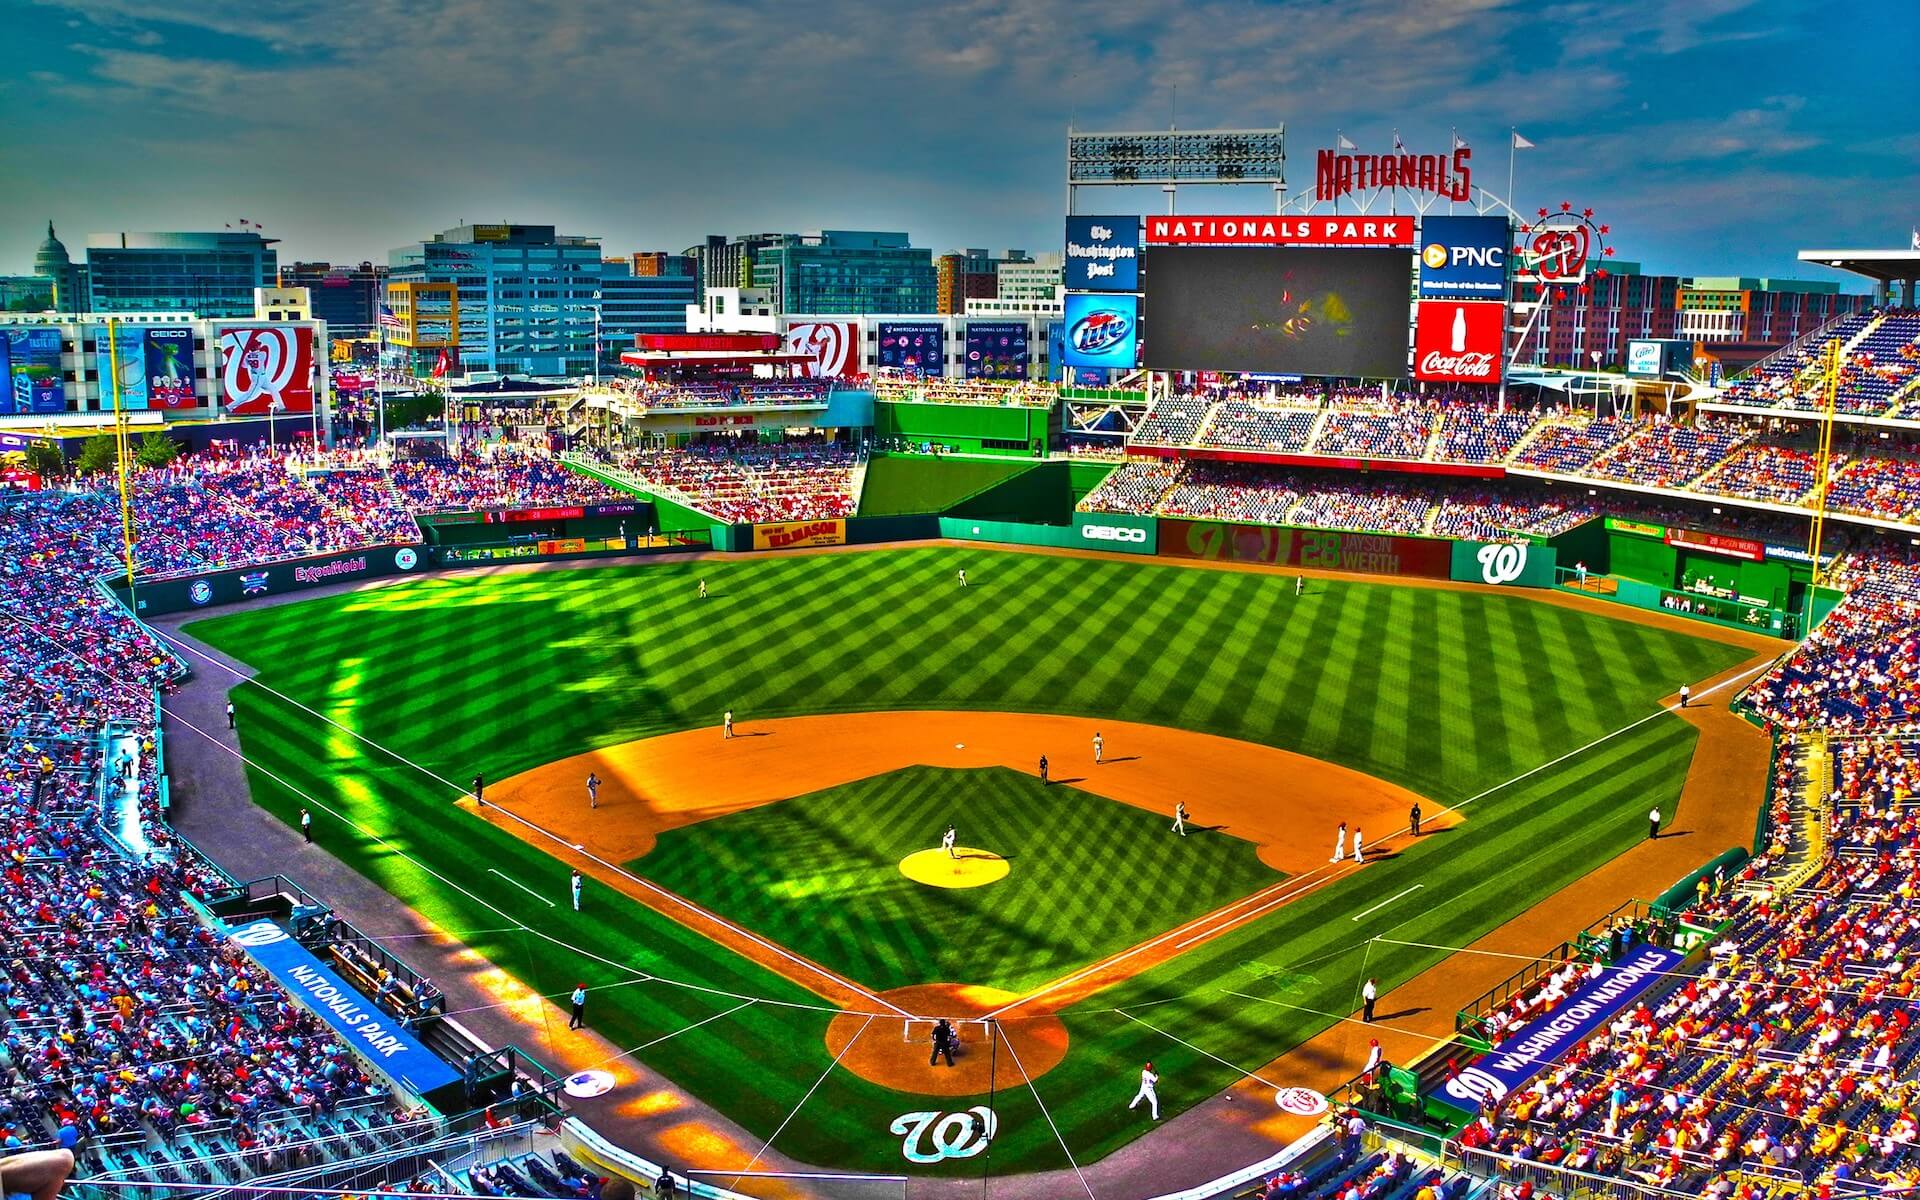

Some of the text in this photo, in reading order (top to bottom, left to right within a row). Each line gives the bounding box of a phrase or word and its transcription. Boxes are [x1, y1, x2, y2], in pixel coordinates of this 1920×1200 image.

[1316, 148, 1472, 202] NATIONALS
[1090, 225, 1113, 241] The
[1155, 222, 1397, 238] NATIONALS PARK
[1067, 241, 1136, 261] Washington
[1450, 247, 1504, 267] PNC
[1087, 263, 1114, 280] Post
[150, 330, 187, 338] GEICO
[1421, 351, 1496, 377] Coca-Cola
[1082, 524, 1147, 543] GEICO
[1343, 533, 1392, 553] JAYSON
[1301, 532, 1341, 568] 28
[294, 556, 367, 582] ExxonMobil
[1343, 550, 1400, 573] WERTH
[288, 964, 366, 1027] NATIONALS
[1493, 950, 1668, 1073] WASHINGTON NATIONALS
[355, 1019, 409, 1058] PARK
